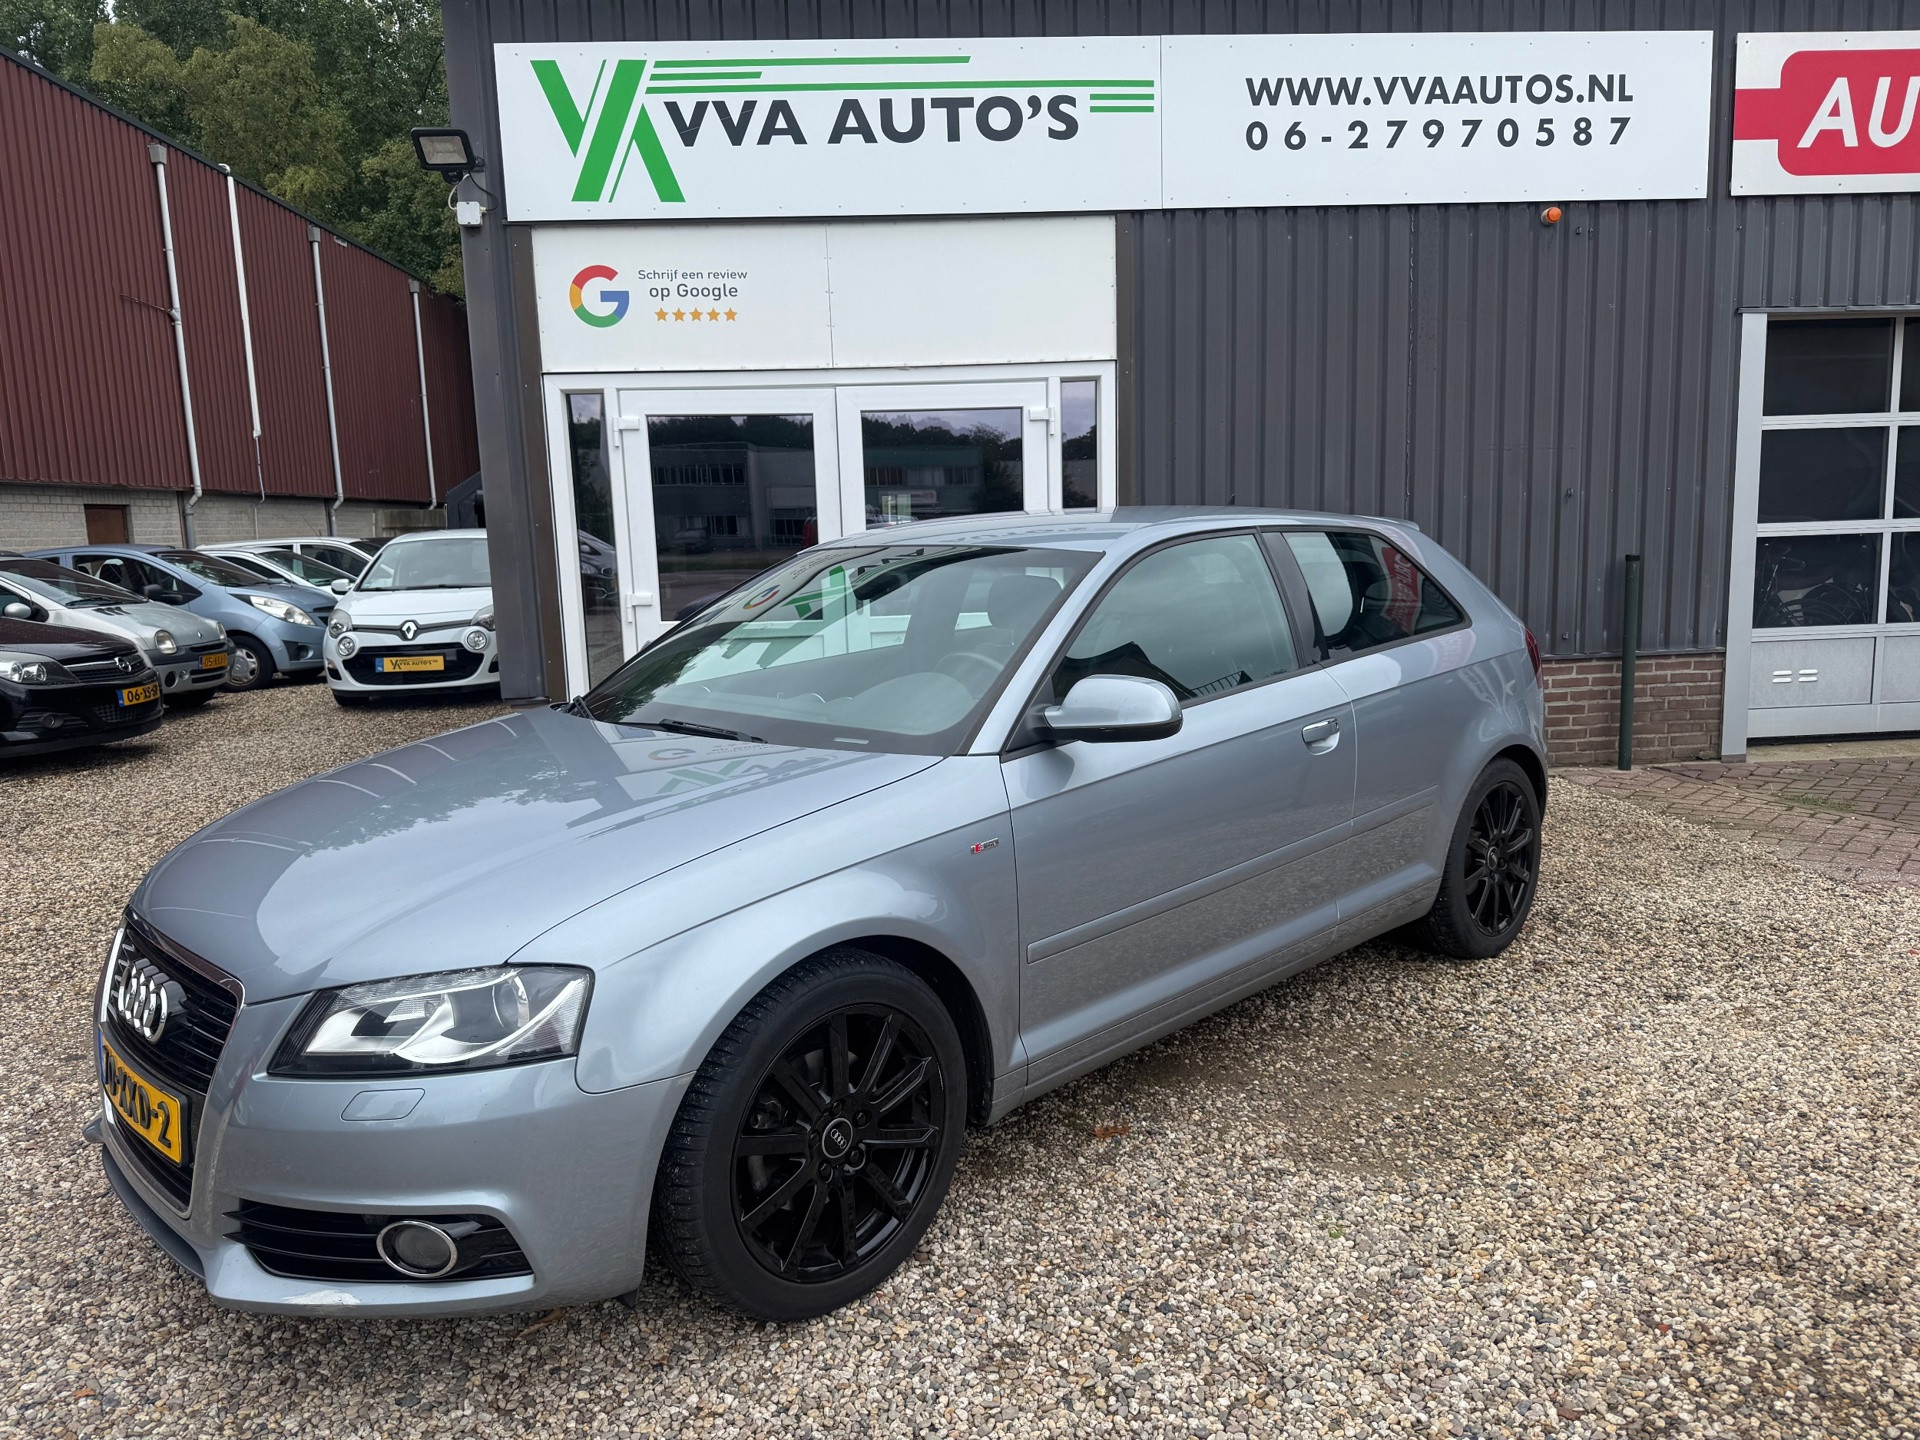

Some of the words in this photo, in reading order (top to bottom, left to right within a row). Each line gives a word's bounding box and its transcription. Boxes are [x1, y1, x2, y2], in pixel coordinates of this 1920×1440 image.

[1245, 73, 1634, 106] WWW.VVAAUTOS.NL
[663, 99, 808, 147] VVA
[827, 95, 1079, 145] AUTO'S
[1797, 76, 1920, 148] AU
[1245, 116, 1631, 151] 06-27970587
[638, 269, 678, 281] Schrijf
[681, 271, 704, 280] een
[707, 270, 748, 280] review
[649, 286, 671, 301] op
[676, 284, 738, 301] Google
